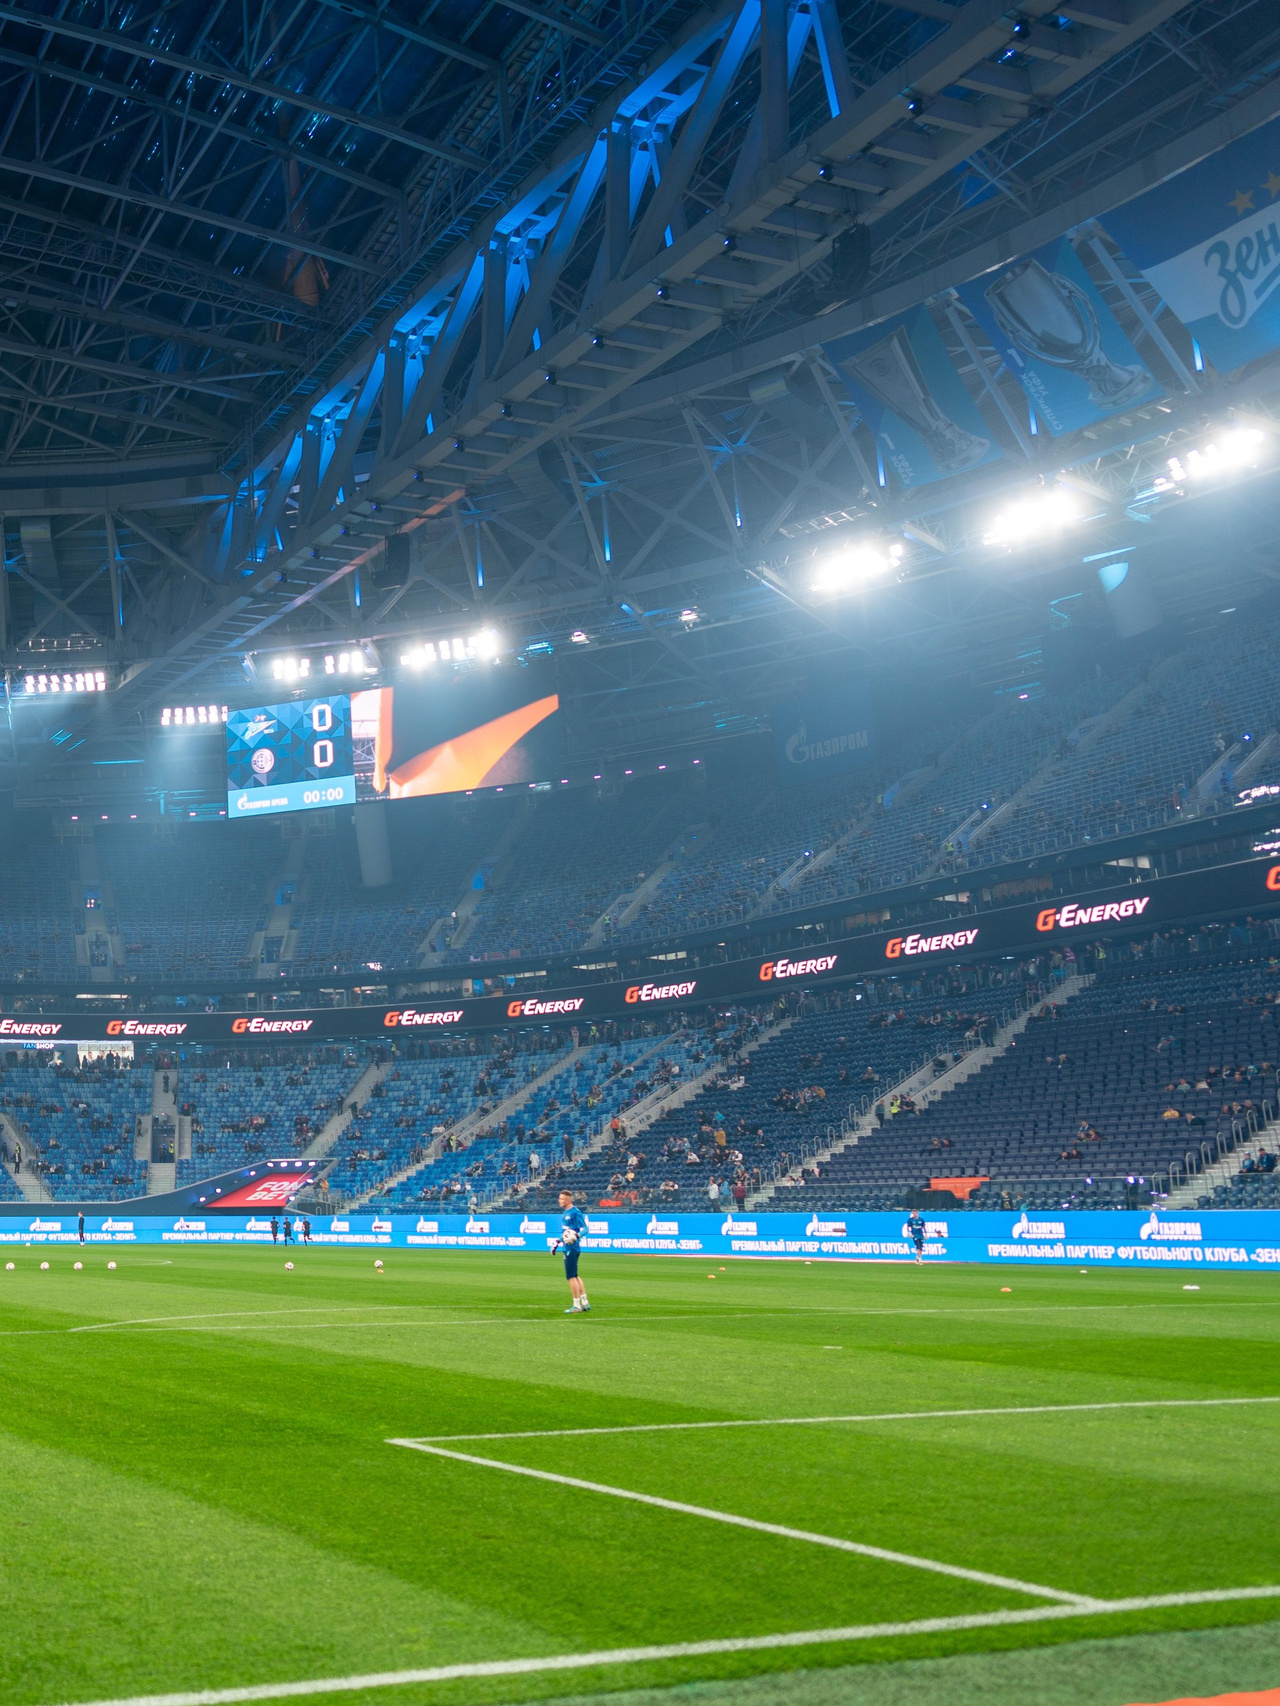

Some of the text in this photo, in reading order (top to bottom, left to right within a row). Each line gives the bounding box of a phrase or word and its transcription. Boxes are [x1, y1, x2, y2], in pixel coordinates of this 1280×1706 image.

[1006, 348, 1024, 367] 1
[1028, 370, 1050, 396] УЕФА
[1019, 372, 1063, 431] СУПЕРКУБОК
[880, 432, 896, 450] 1
[889, 455, 912, 485] КУБОК
[897, 453, 915, 477] УЕФА
[312, 703, 332, 732] 0
[313, 739, 334, 768] 0
[809, 730, 869, 760] ГАЗПРОМ
[303, 787, 344, 803] 00:00
[245, 1191, 299, 1201] BET
[255, 1181, 305, 1191] FON
[1158, 1222, 1202, 1235] ГАЗПРОМ
[731, 1238, 785, 1252] ПРЕМИАЛЬНЫЙ
[786, 1241, 820, 1252] ПАРТНЕР
[821, 1241, 880, 1254] ФУТБОЛЬНОГО
[880, 1242, 911, 1255] КЛУБА
[988, 1242, 1065, 1258] ПРЕМИАЛЬНЫЙ
[1066, 1245, 1116, 1258] ПАРТНЕР
[1117, 1246, 1203, 1261] ФУТБОЛЬНОГО
[1204, 1247, 1249, 1262] КЛУБА
